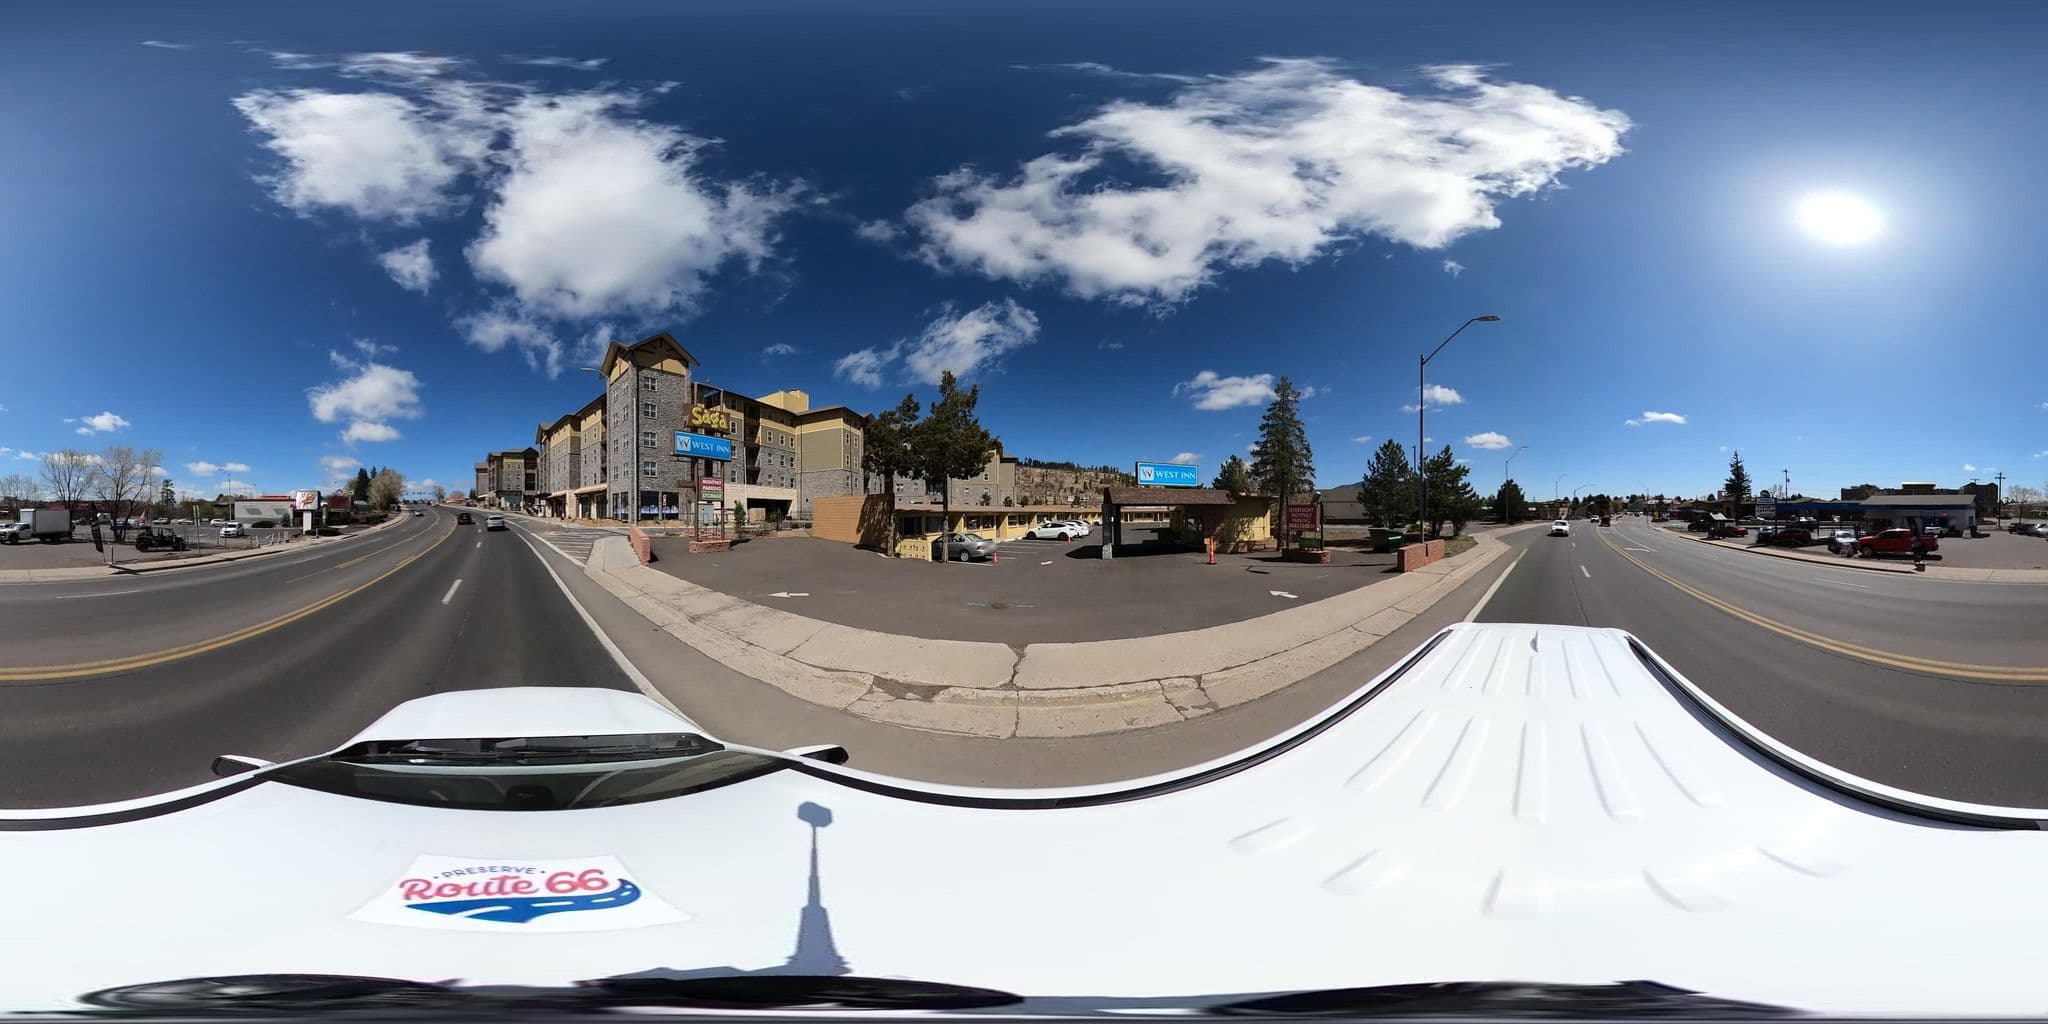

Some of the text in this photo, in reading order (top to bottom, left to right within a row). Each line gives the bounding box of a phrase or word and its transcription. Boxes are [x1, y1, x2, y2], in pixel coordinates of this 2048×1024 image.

[692, 406, 728, 428] Saga
[692, 441, 715, 451] WEST
[716, 445, 730, 453] INN
[1155, 469, 1178, 478] WEST
[443, 865, 536, 879] PRESERVE
[399, 868, 610, 901] Route 66
